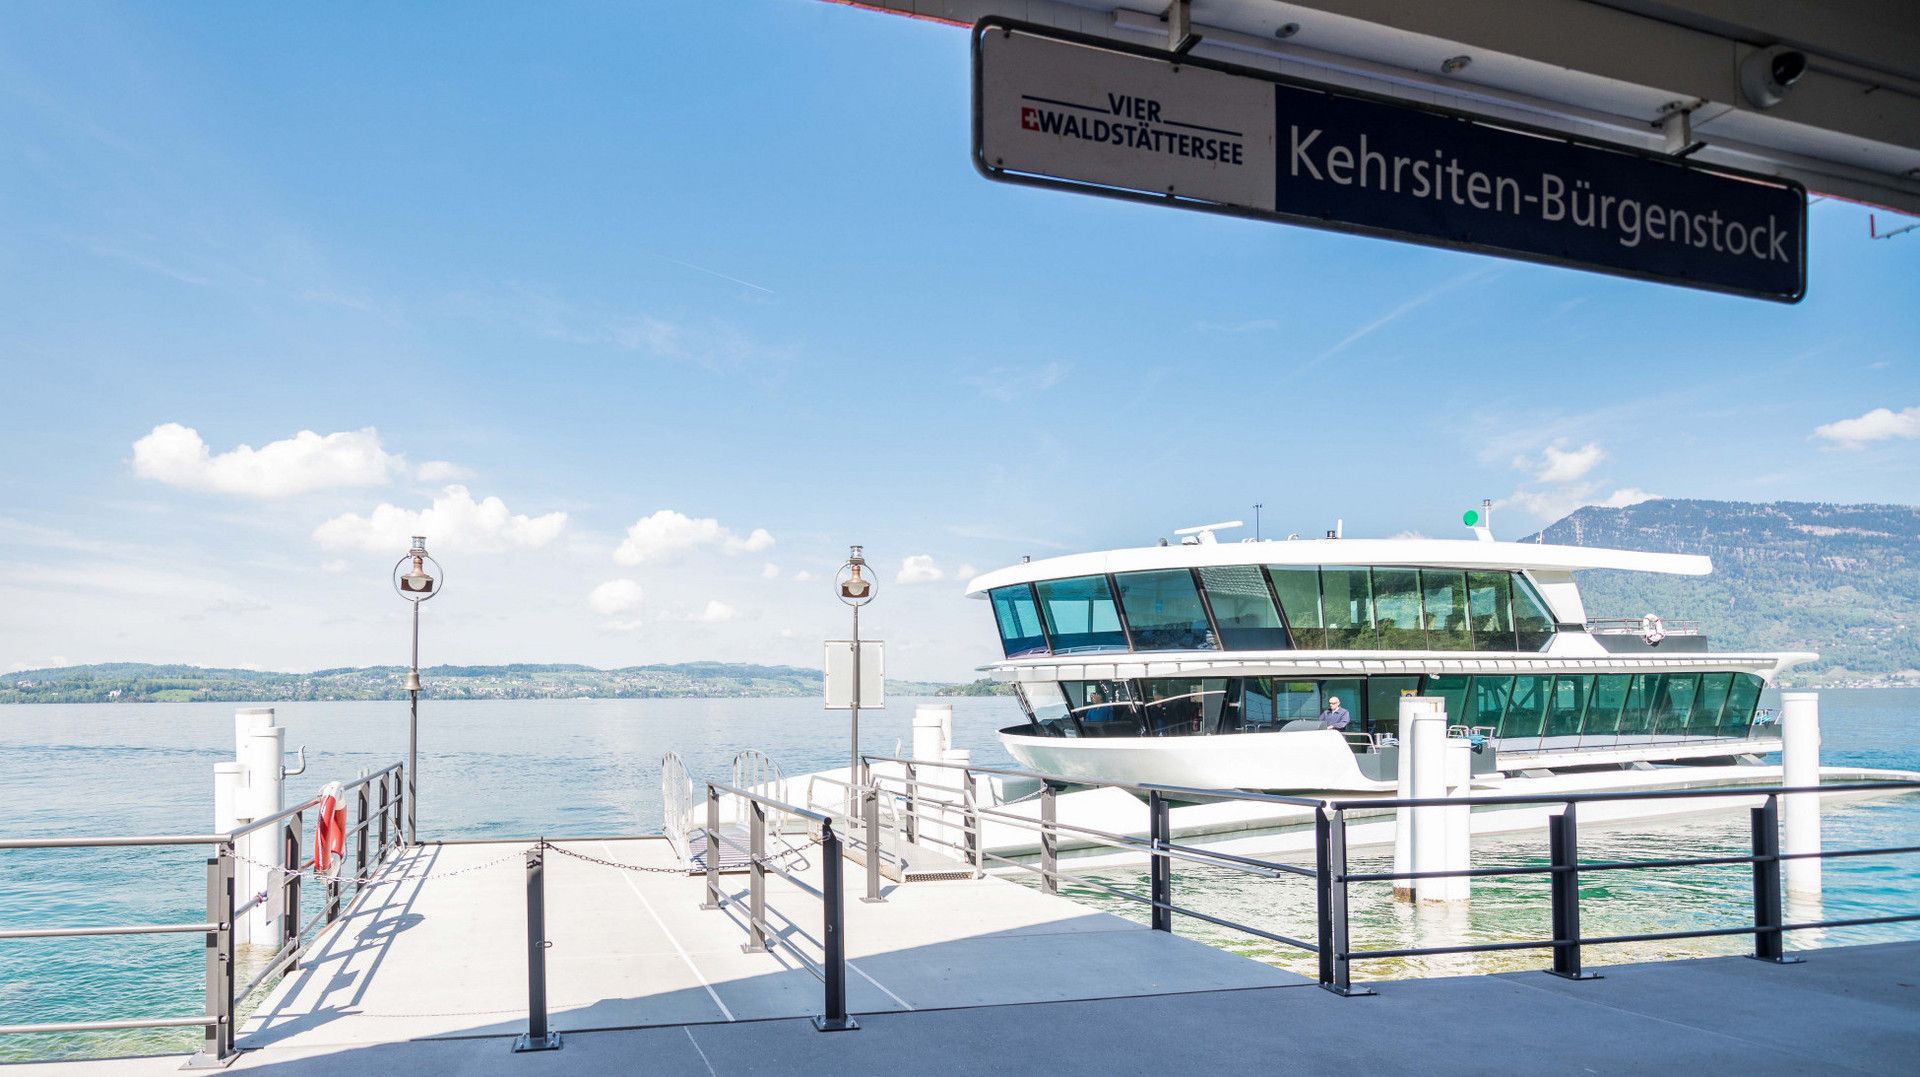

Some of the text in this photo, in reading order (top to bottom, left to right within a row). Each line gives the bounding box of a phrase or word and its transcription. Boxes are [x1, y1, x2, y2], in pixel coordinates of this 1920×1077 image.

[1108, 93, 1161, 123] VIER
[1038, 110, 1243, 165] WALDSTÄTTERSEE
[1290, 126, 1789, 263] Kehrsiten-Bürgenstock
